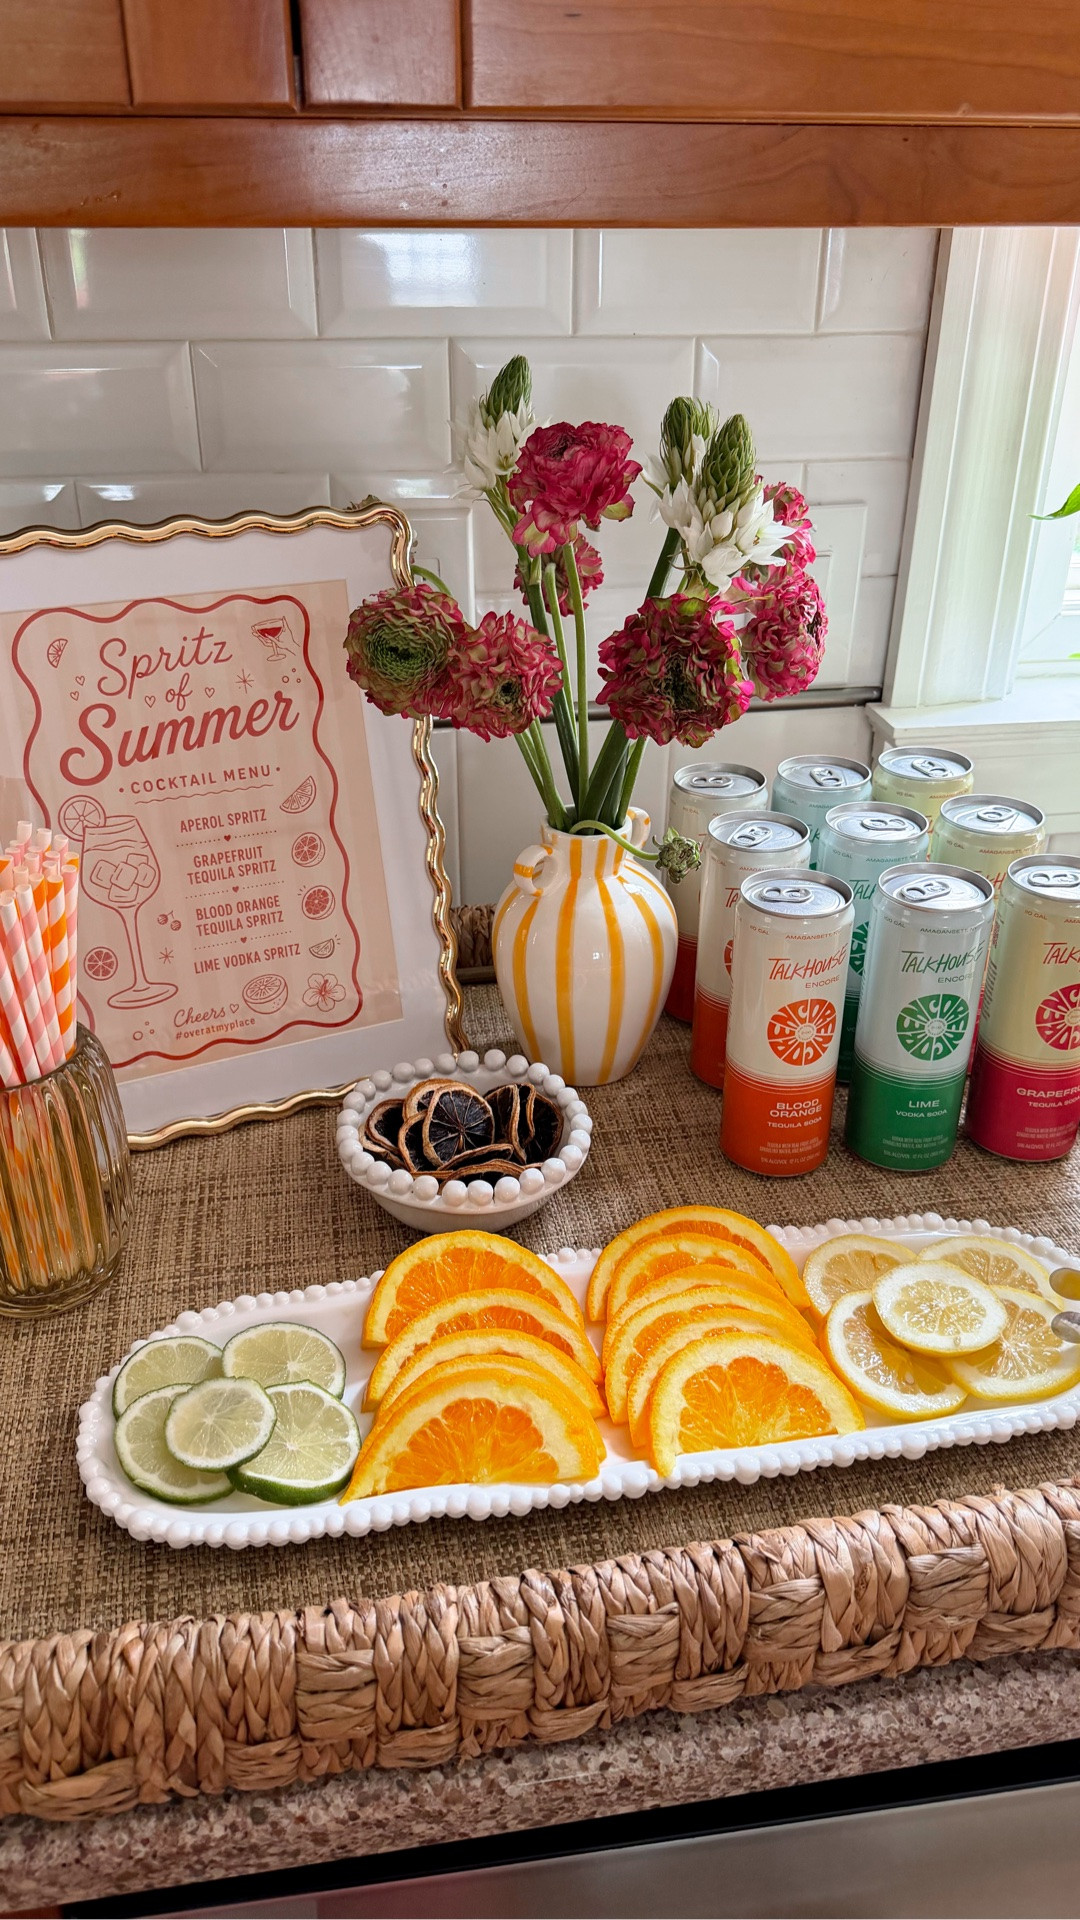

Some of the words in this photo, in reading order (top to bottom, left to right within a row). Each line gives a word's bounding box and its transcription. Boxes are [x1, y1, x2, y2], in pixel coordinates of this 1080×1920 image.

[97, 626, 233, 699] Spritz
[165, 672, 194, 712] of
[59, 690, 300, 786] Summer
[130, 771, 217, 795] COCKTAIL
[224, 765, 271, 783] MENU
[180, 815, 225, 834] APEROL
[227, 808, 267, 825] SPRITZ
[193, 846, 263, 868] GRAPEFRUIT
[187, 866, 235, 885] TEQUILA
[238, 860, 277, 877] SPRITZ
[195, 903, 233, 921] BLOOD
[236, 895, 281, 916] ORANGE
[195, 918, 244, 937] TEQUILA
[246, 910, 284, 929] SPRITZ
[194, 958, 221, 974] LIME
[223, 952, 262, 969] VODKA
[264, 943, 301, 961] SPRITZ
[768, 942, 848, 980] TALKHOUSE
[901, 940, 985, 974] TALKHOUSE
[1043, 942, 1080, 965] TALK
[805, 975, 840, 989] ENCORE
[173, 1007, 226, 1028] Cheers
[175, 1017, 256, 1040] #overatmyplace
[770, 1104, 822, 1118] ORANGE
[776, 1098, 819, 1110] BLOOD
[896, 1110, 925, 1118] VODKA
[926, 1109, 948, 1117] SODA
[908, 1099, 940, 1108] LIME
[767, 1121, 802, 1129] TEQUILA
[803, 1116, 822, 1126] SODA
